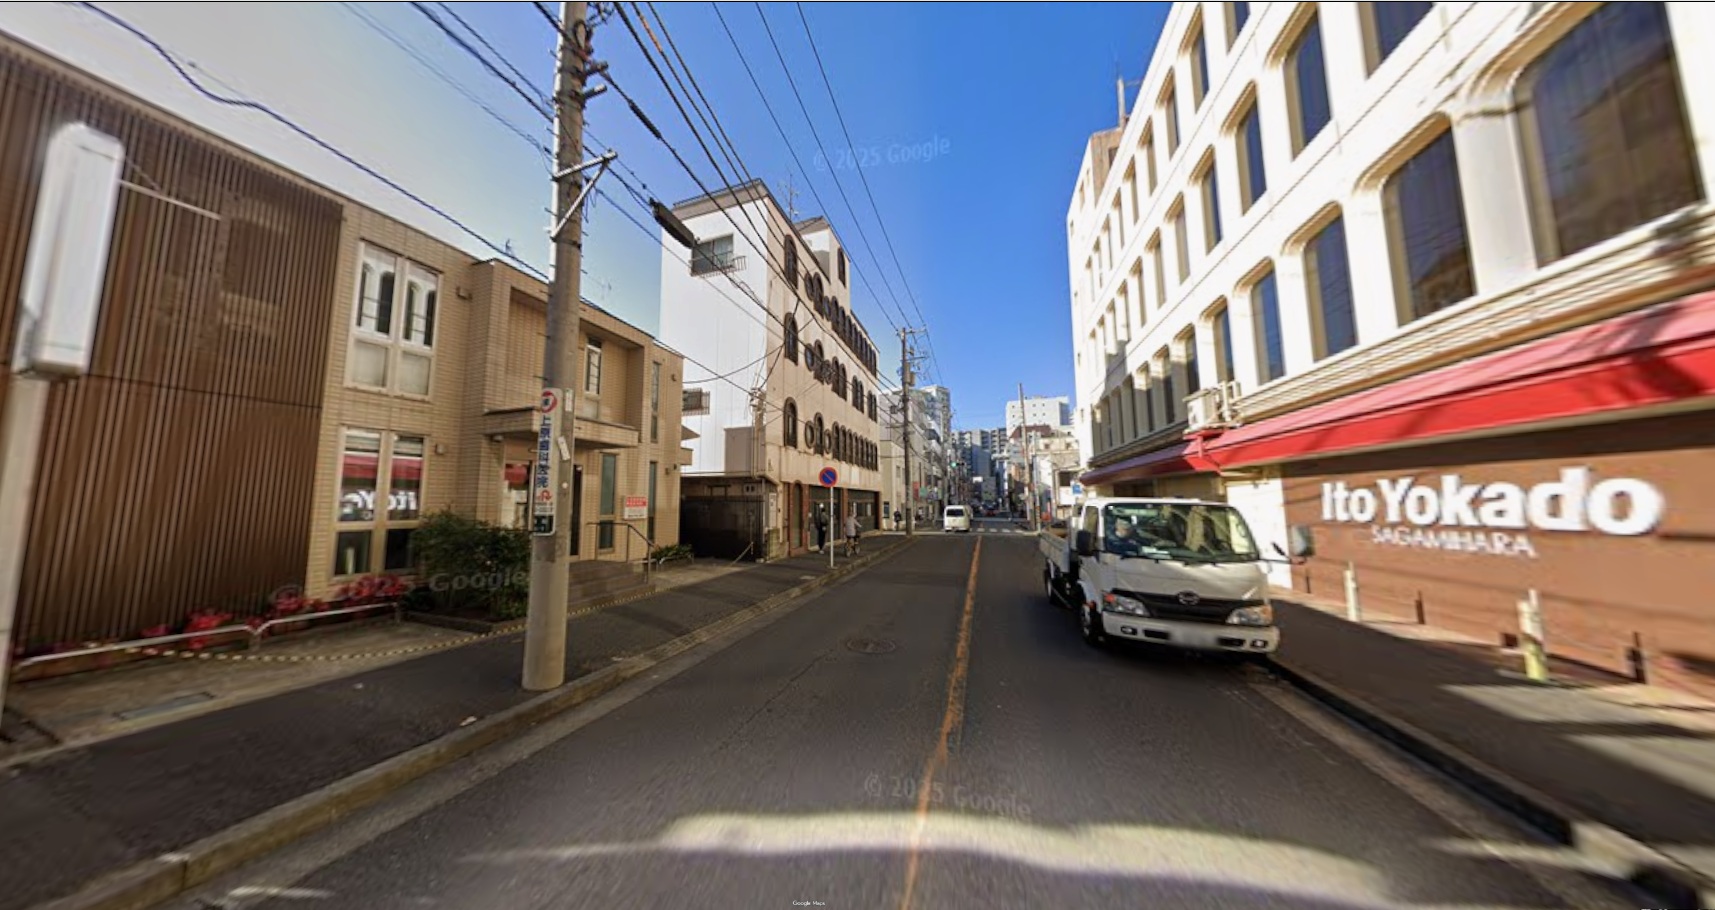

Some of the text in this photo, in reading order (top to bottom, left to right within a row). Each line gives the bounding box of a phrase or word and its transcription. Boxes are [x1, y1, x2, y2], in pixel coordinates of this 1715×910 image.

[1321, 464, 1665, 536] Ito Yokado
[1371, 524, 1540, 558] SAGAMIHARA
